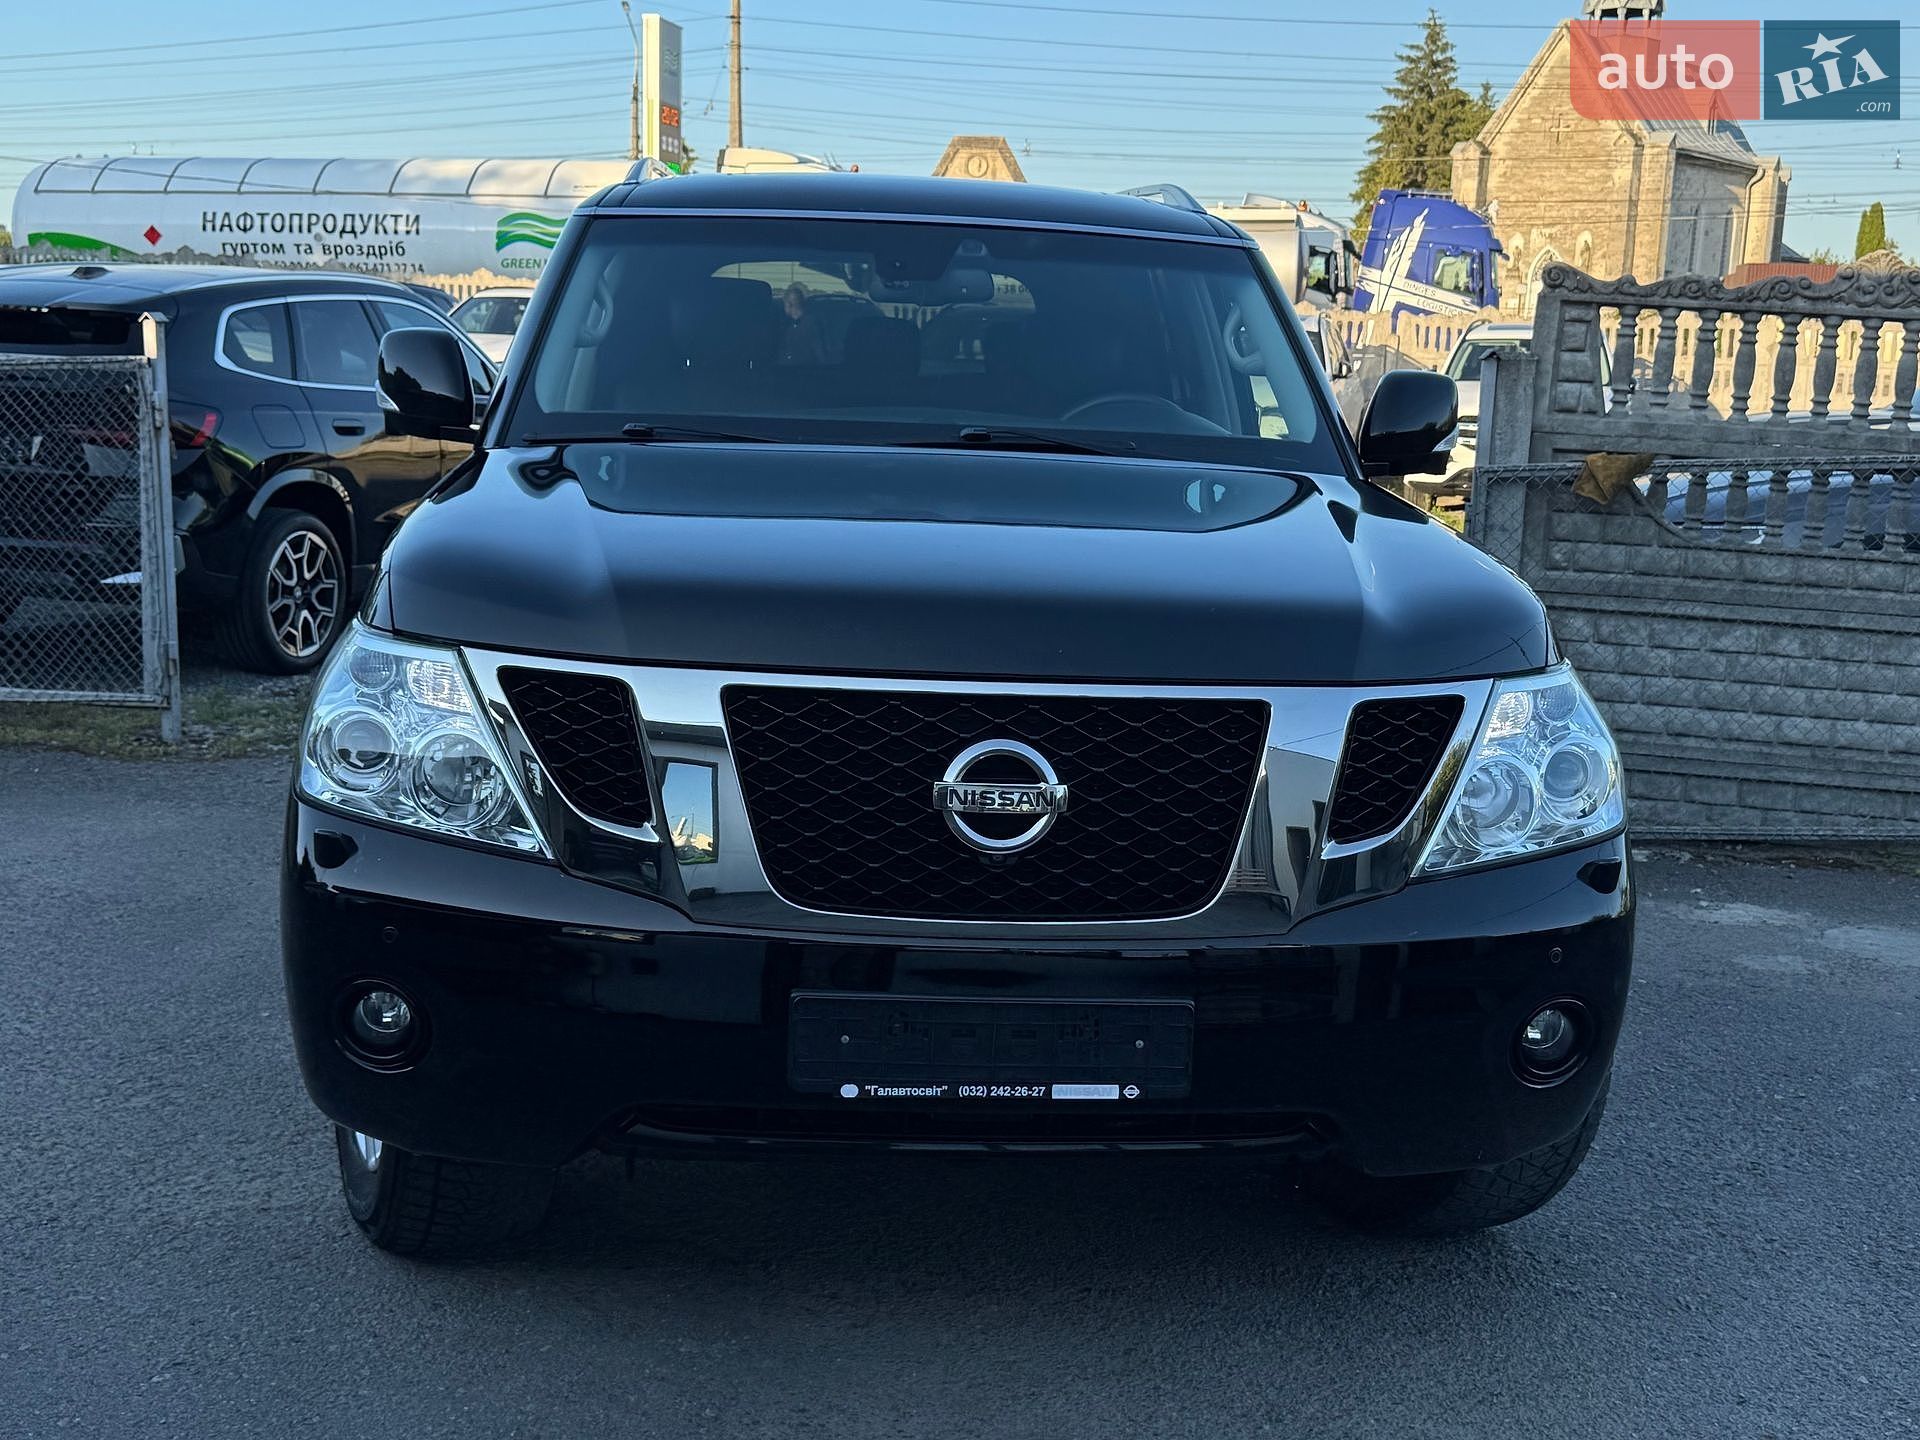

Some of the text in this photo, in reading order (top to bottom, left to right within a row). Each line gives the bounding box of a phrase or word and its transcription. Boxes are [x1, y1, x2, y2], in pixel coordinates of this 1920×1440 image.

[201, 211, 421, 237] НАФТОПРОДУКТИ
[222, 240, 406, 260] гуртом та вроздріб
[501, 257, 541, 269] GREEN
[948, 788, 1055, 808] NISSAN
[865, 1085, 948, 1097] "Галавтосвіт"
[958, 1085, 987, 1098] (032)
[990, 1085, 1046, 1097] 242-26-27
